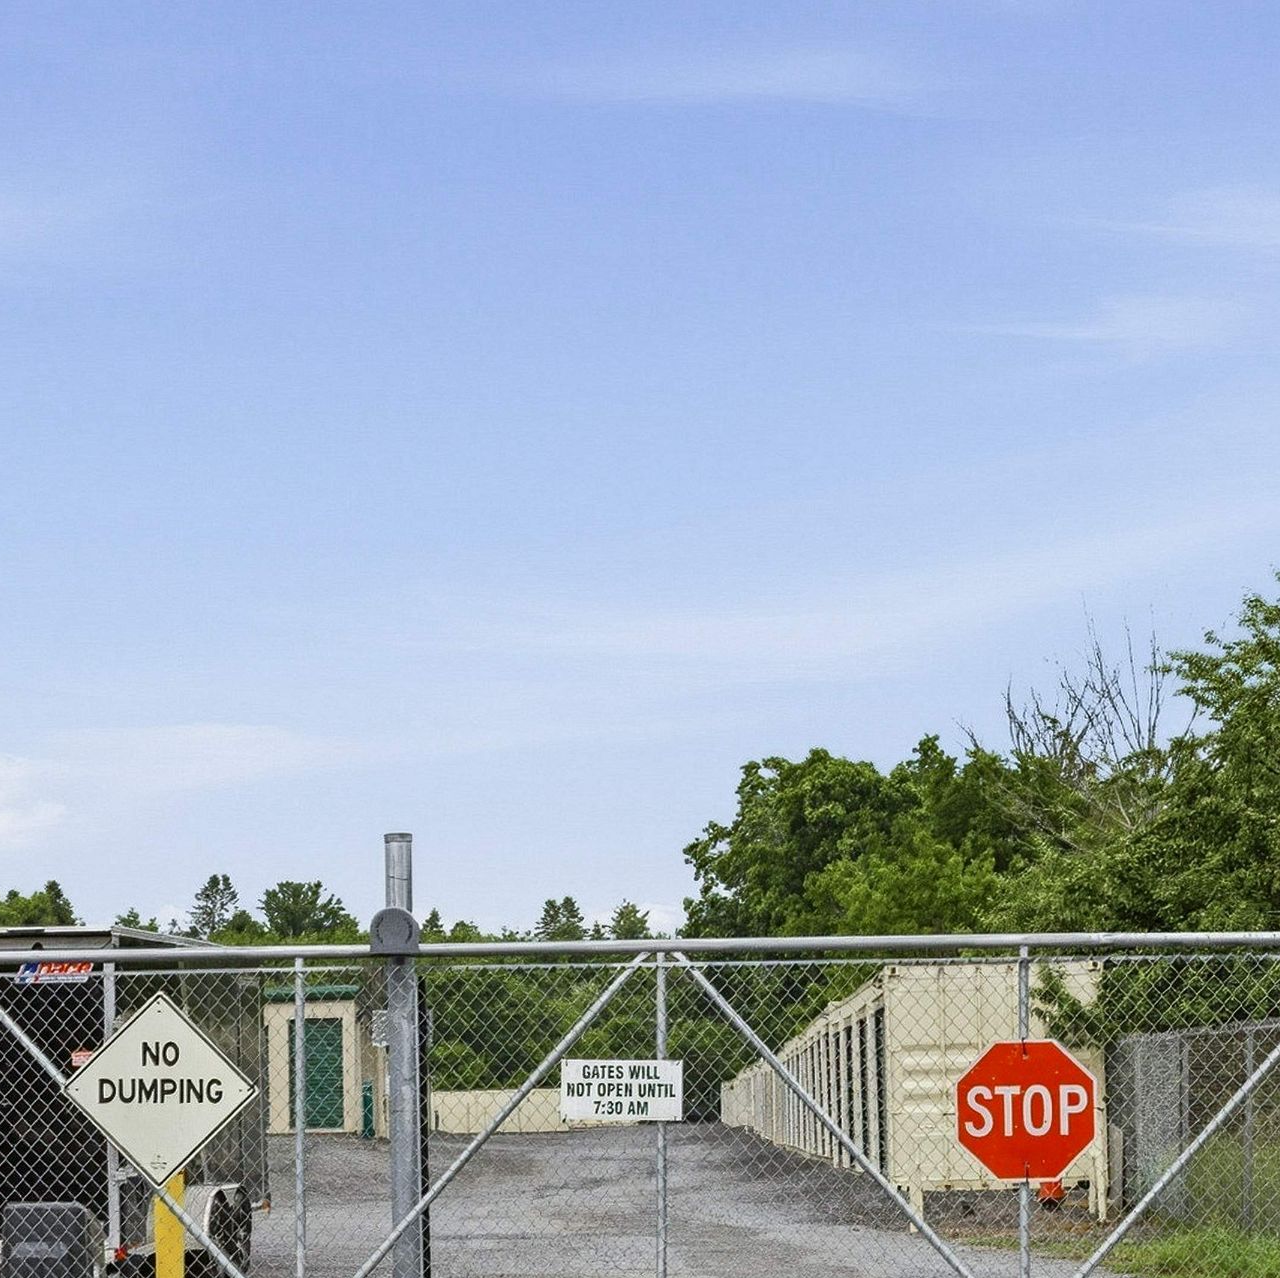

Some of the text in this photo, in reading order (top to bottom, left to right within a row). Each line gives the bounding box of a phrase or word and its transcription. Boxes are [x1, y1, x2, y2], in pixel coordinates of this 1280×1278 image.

[141, 1041, 180, 1067] NO
[582, 1065, 660, 1080] GATES WILL
[98, 1078, 223, 1104] DUMPING
[566, 1082, 676, 1098] NOT OPEN UNTIL
[593, 1100, 649, 1116] 7:30 AM
[964, 1084, 1088, 1137] STOP
